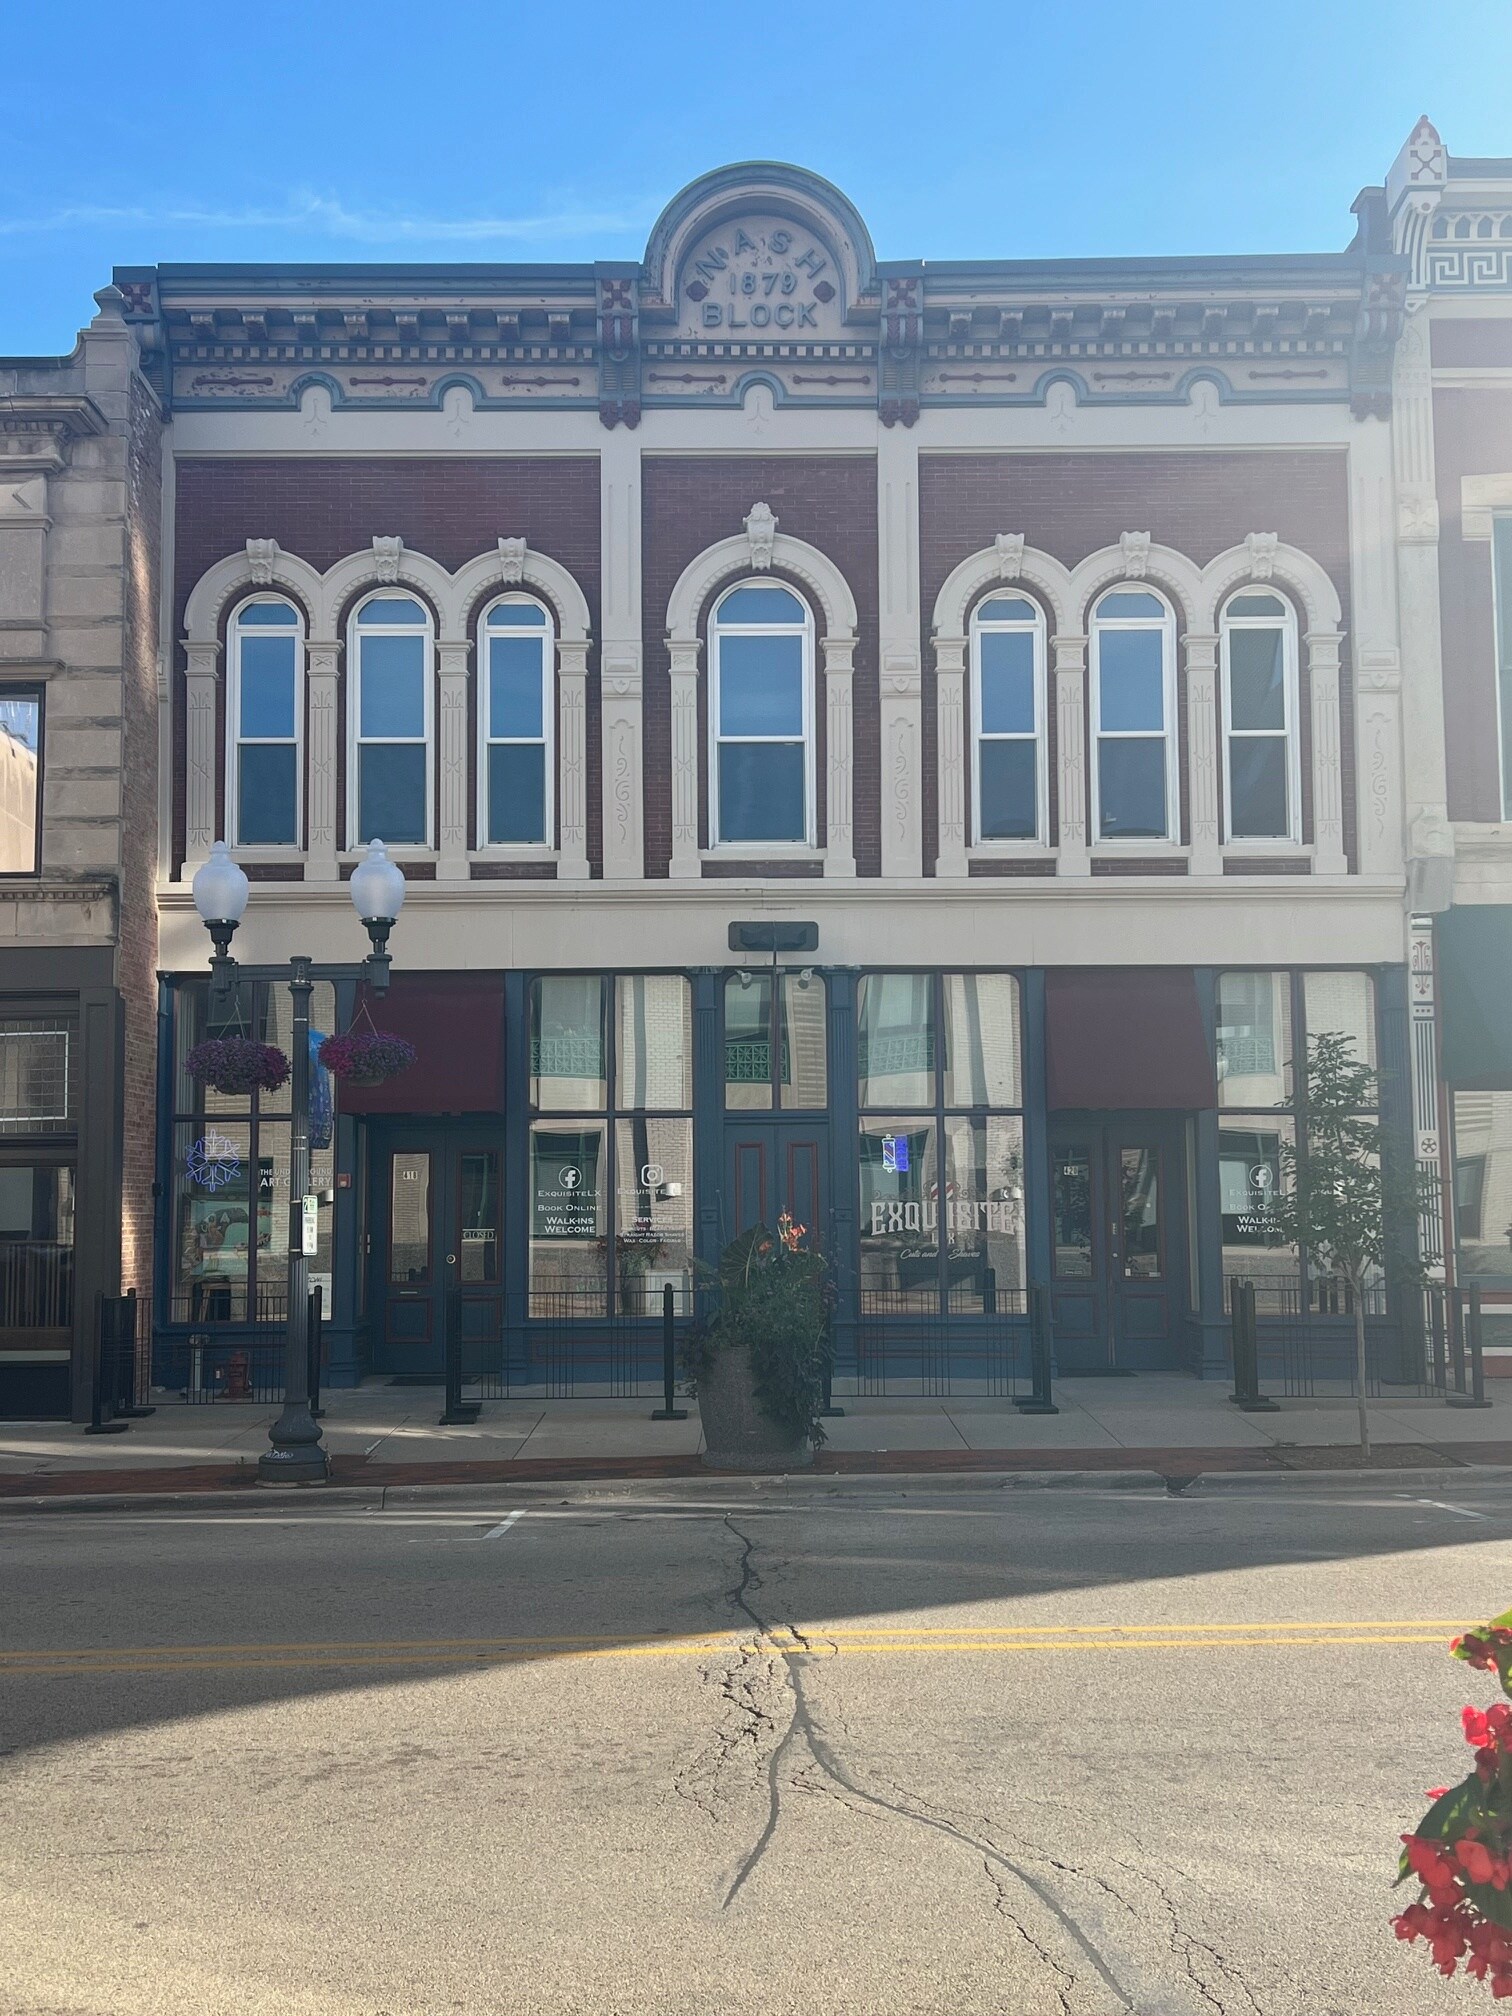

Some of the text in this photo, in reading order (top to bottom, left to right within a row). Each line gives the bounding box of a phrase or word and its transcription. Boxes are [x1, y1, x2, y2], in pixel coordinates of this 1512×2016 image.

[730, 272, 798, 296] 1879
[702, 301, 818, 328] BLOCK
[260, 1168, 333, 1176] THE UNDOUND
[260, 1177, 332, 1187] ART GLERY
[546, 1217, 594, 1225] WALK-INS
[871, 1201, 1015, 1235] EXQUISITE
[544, 1225, 596, 1233] WELCOME
[462, 1231, 494, 1240] CLOSED
[921, 1249, 938, 1258] and
